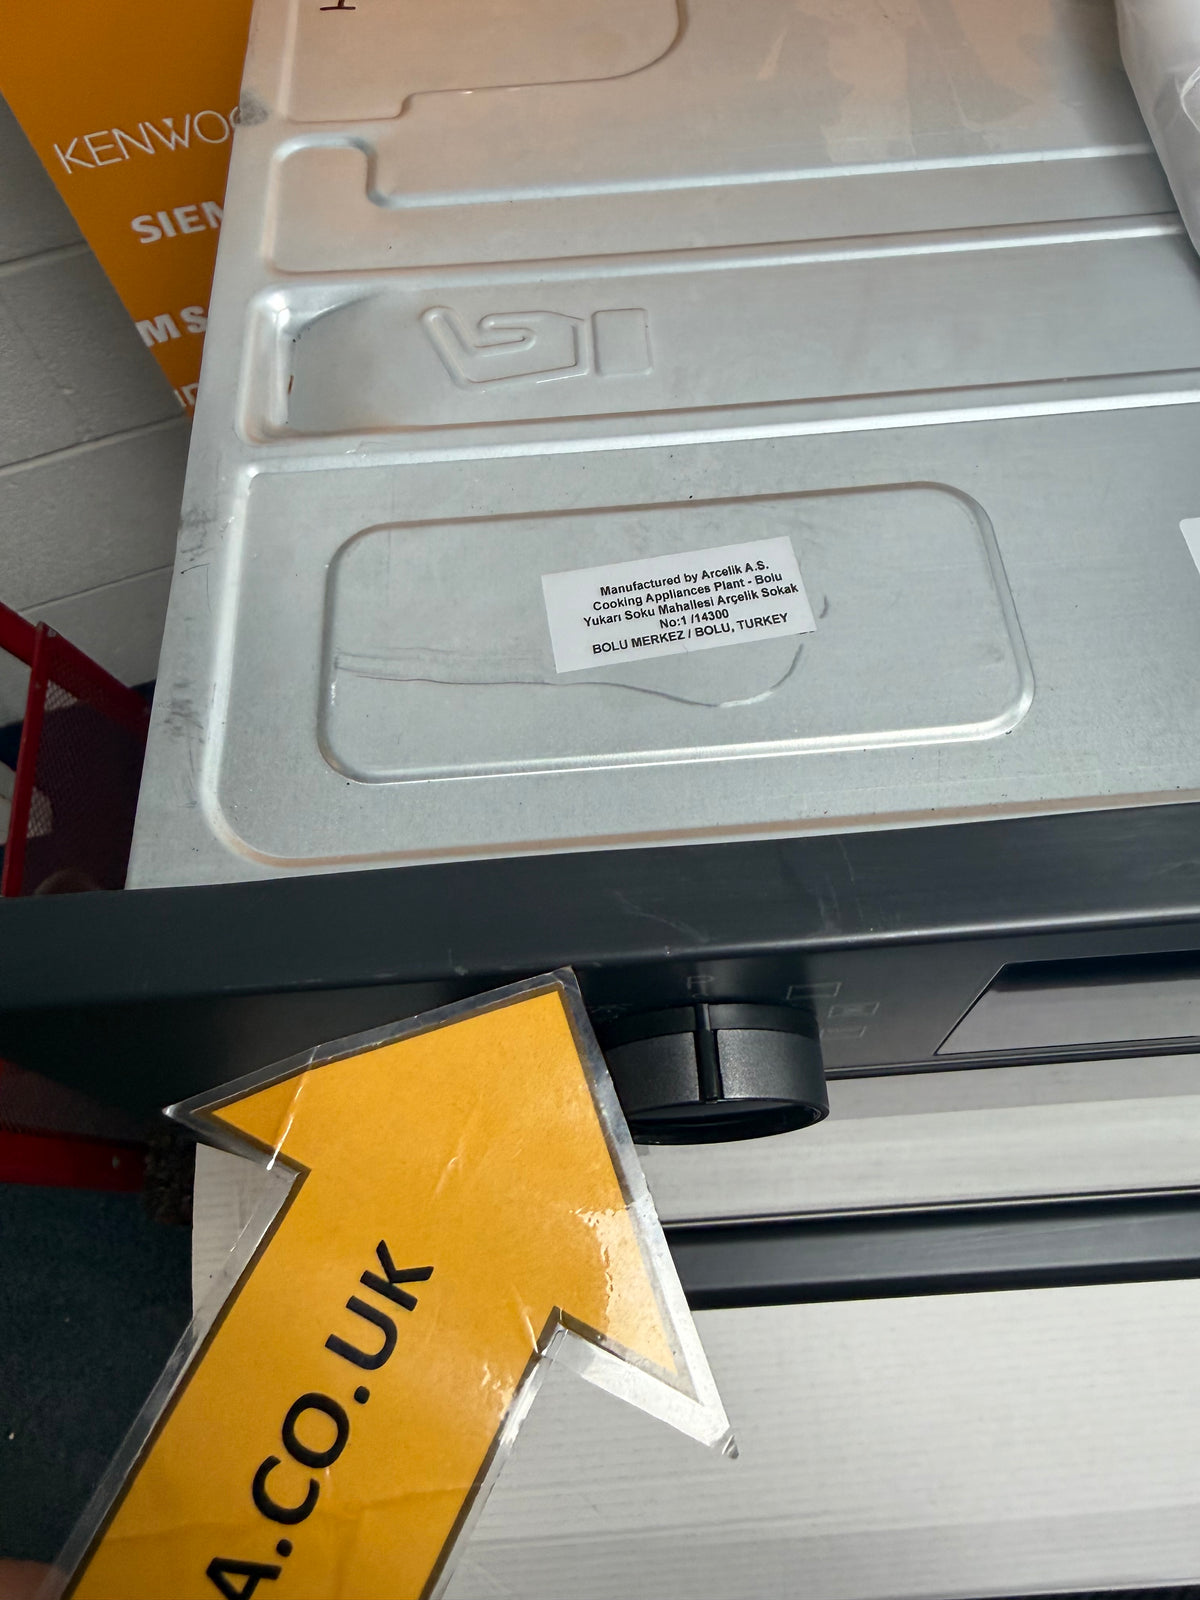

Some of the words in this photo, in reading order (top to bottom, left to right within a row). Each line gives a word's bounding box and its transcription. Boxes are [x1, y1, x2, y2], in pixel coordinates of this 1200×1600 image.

[593, 596, 643, 611] Cooking
[646, 584, 711, 604] Appliances
[714, 578, 746, 592] Plant
[755, 573, 783, 585] Bolu
[600, 574, 681, 596] Manufactured
[684, 573, 698, 583] by
[702, 564, 743, 580] Arcelik
[745, 560, 769, 573] A.S.
[583, 614, 622, 627] Yukarı
[624, 608, 656, 621] Soku
[658, 596, 714, 615] Mahallesi
[717, 590, 759, 606] Arçelik
[761, 583, 799, 598] Sokak
[660, 615, 687, 629] No:1
[691, 608, 730, 624] /14300
[592, 639, 629, 655] BOLU
[631, 630, 686, 648] MERKEZ
[688, 629, 692, 639] /
[695, 622, 735, 637] BOLU,
[736, 612, 788, 630] TURKEY
